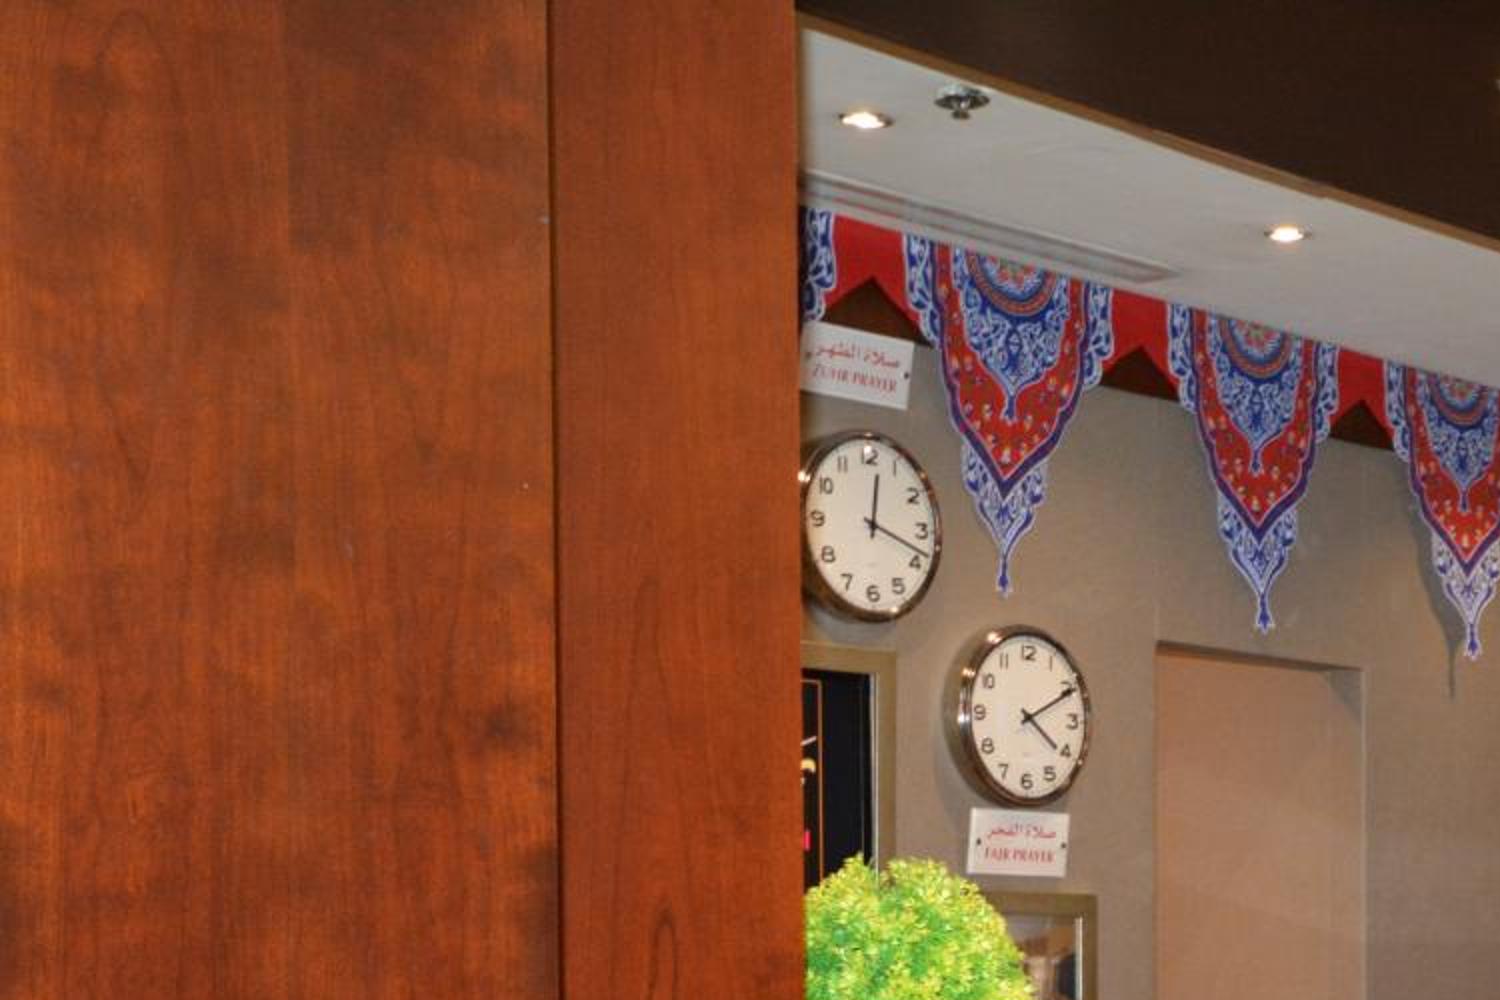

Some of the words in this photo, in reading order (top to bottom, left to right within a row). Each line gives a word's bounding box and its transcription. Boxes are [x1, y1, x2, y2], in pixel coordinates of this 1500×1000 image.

[837, 455, 849, 473] 11
[861, 449, 879, 466] 12
[819, 477, 834, 495] 10
[907, 487, 920, 505] 2
[811, 510, 825, 528] 9
[915, 522, 929, 540] 3
[821, 546, 836, 563] 8
[909, 554, 922, 570] 4
[841, 572, 854, 591] 7
[892, 577, 906, 595] 5
[866, 585, 881, 602] 6
[999, 653, 1009, 669] 11
[1021, 644, 1037, 661] 12
[983, 672, 995, 689] 10
[973, 704, 986, 720] 9
[1066, 713, 1078, 730] 3
[981, 737, 995, 754] 8
[1060, 743, 1072, 758] 4
[998, 763, 1009, 780] 7
[1043, 765, 1057, 782] 5
[1020, 773, 1034, 790] 6
[1011, 848, 1057, 864] PRAYER
